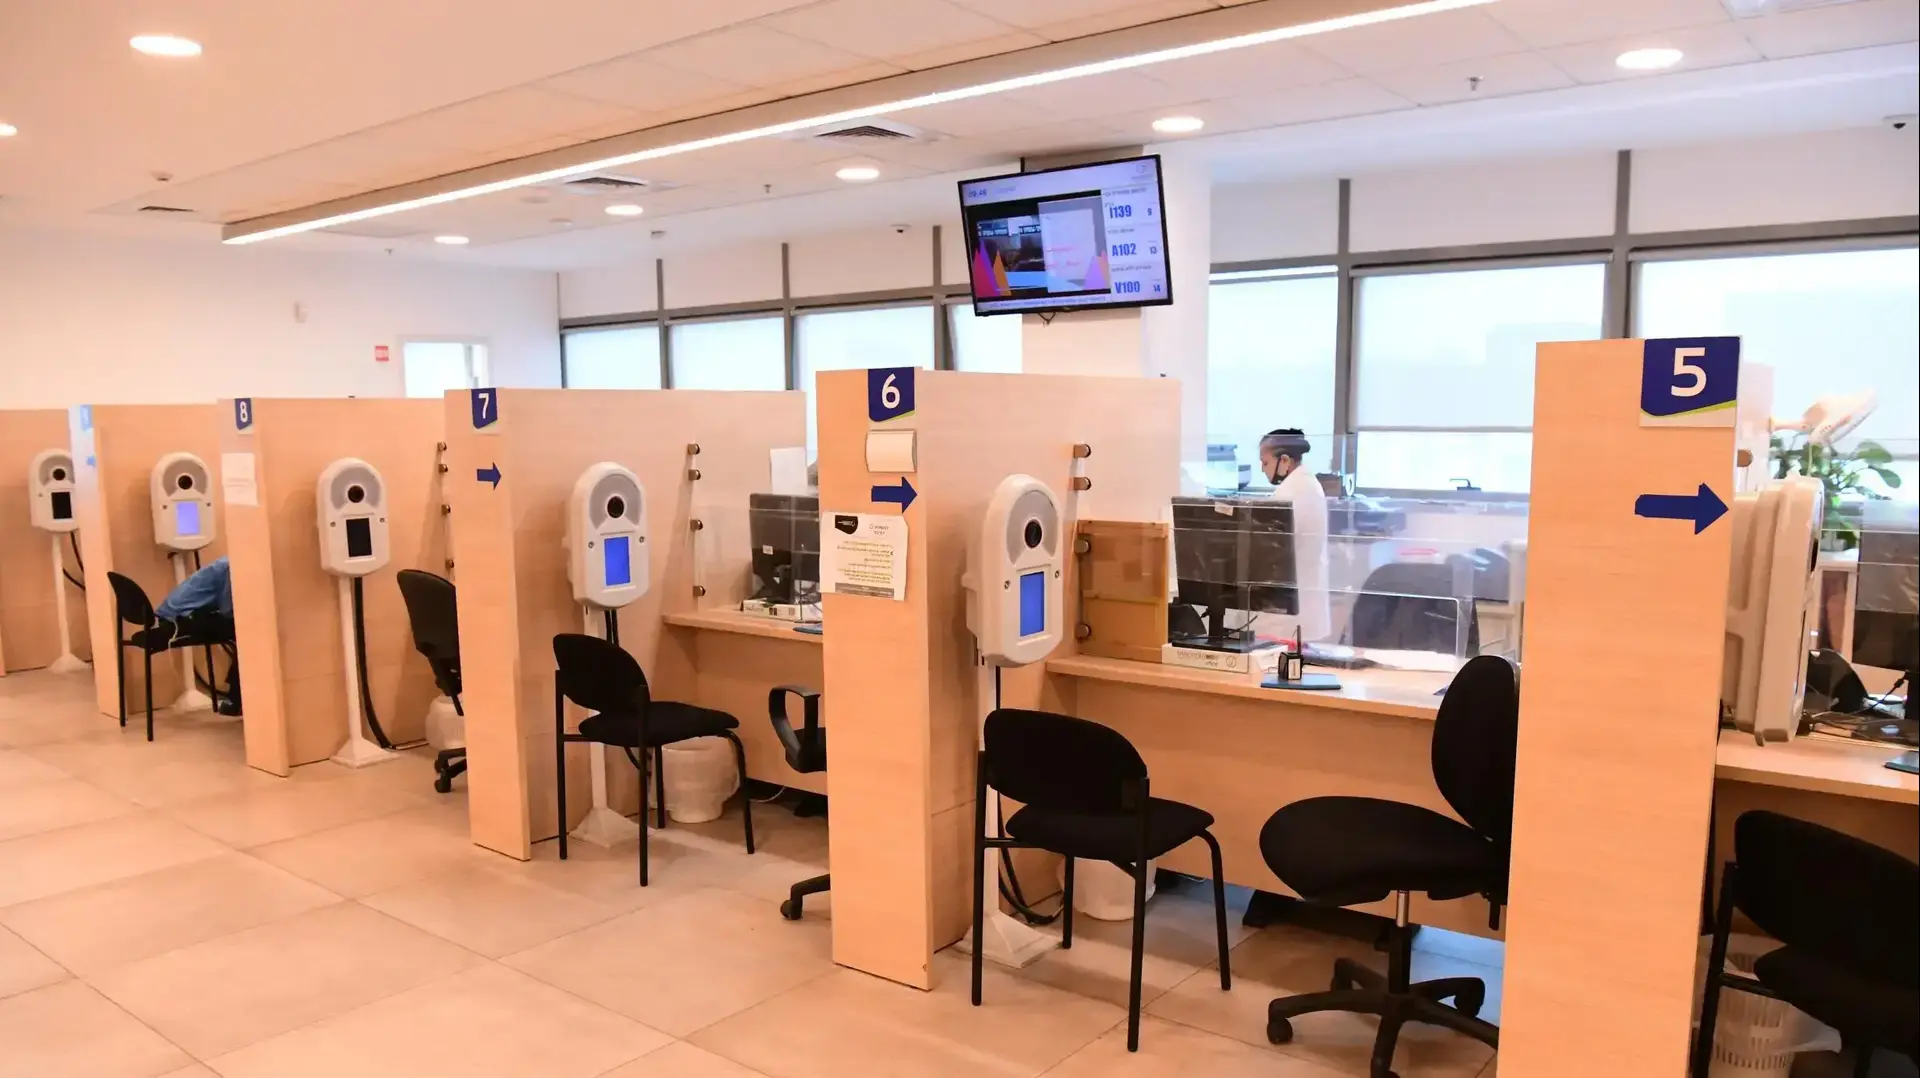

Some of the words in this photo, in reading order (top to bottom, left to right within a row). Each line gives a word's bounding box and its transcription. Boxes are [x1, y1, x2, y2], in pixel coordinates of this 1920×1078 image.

[1112, 243, 1137, 256] A102
[1115, 281, 1141, 294] V100
[1153, 284, 1161, 293] 14
[1671, 347, 1707, 397] 5
[881, 373, 900, 409] 6
[240, 401, 248, 423] 8
[478, 393, 489, 419] 7
